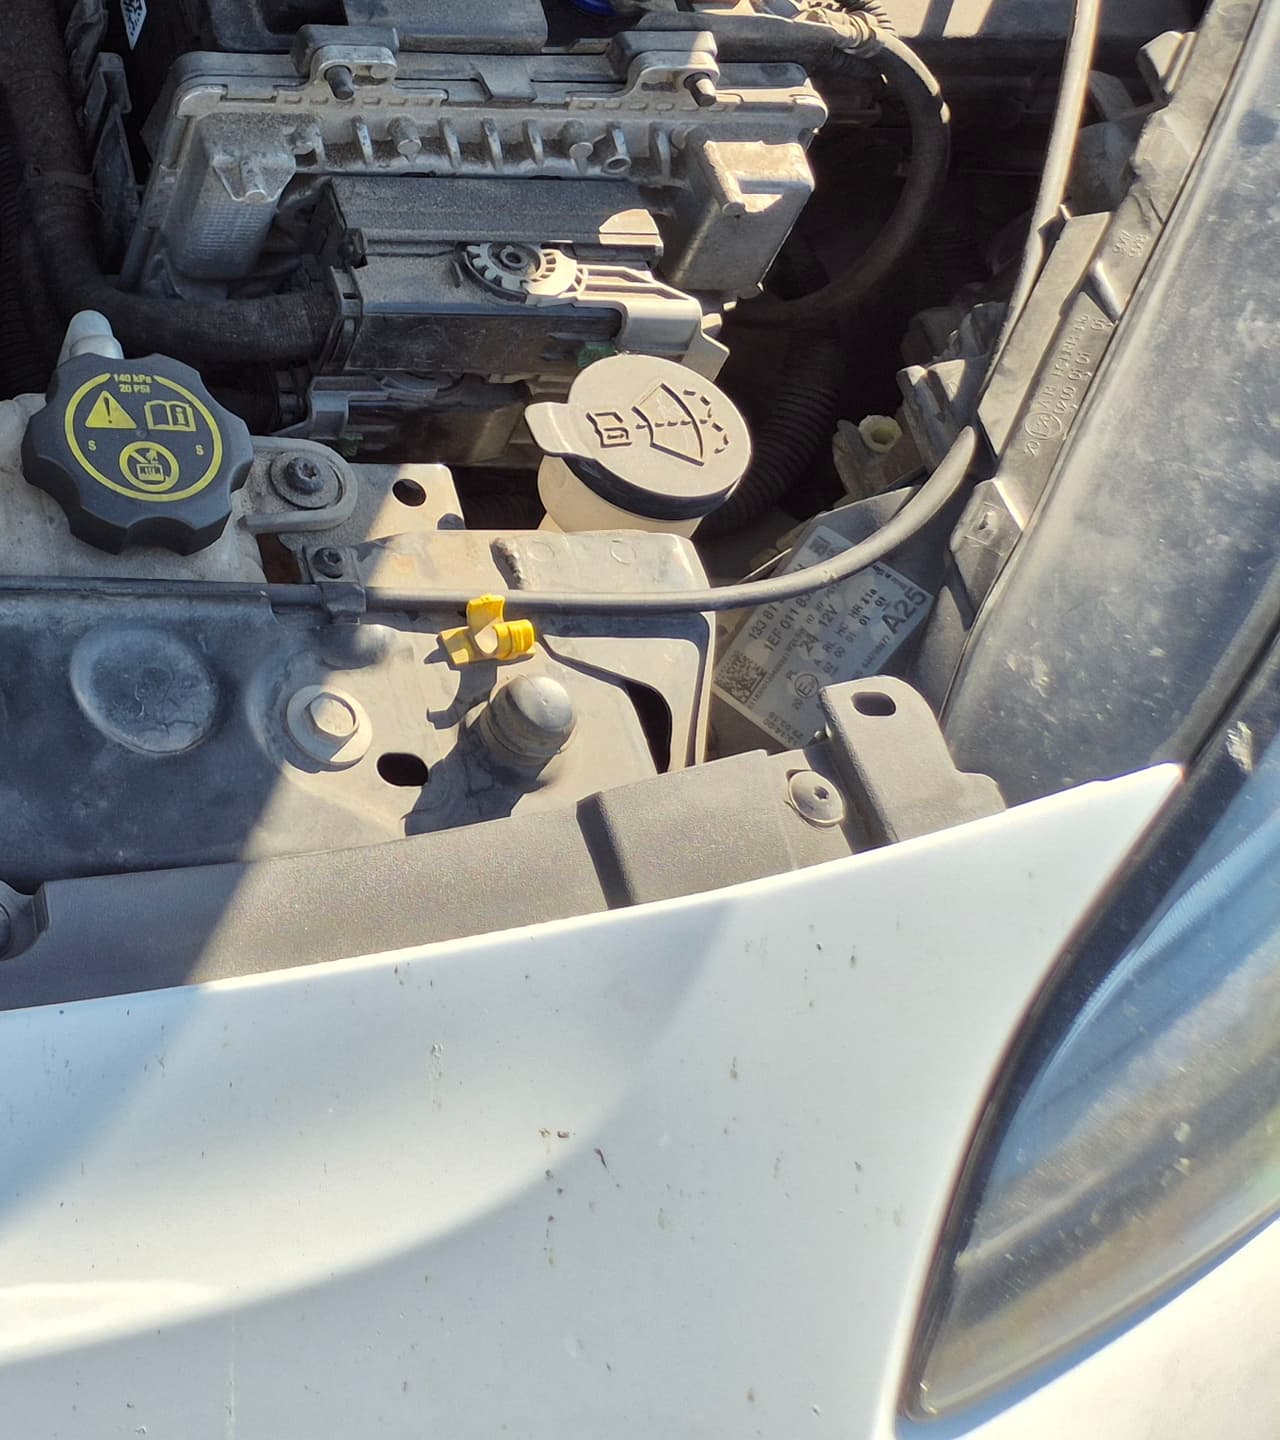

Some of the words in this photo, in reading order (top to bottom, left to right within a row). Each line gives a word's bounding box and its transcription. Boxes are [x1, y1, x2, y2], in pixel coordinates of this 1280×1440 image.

[113, 374, 131, 383] 140
[133, 374, 152, 384] kPa
[119, 384, 132, 393] 20
[133, 385, 151, 393] PSI
[747, 618, 768, 640] 133
[762, 604, 778, 620] 81
[817, 604, 840, 628] 12V
[877, 583, 928, 635] A25
[762, 627, 786, 652] 1EF
[778, 607, 800, 630] 011
